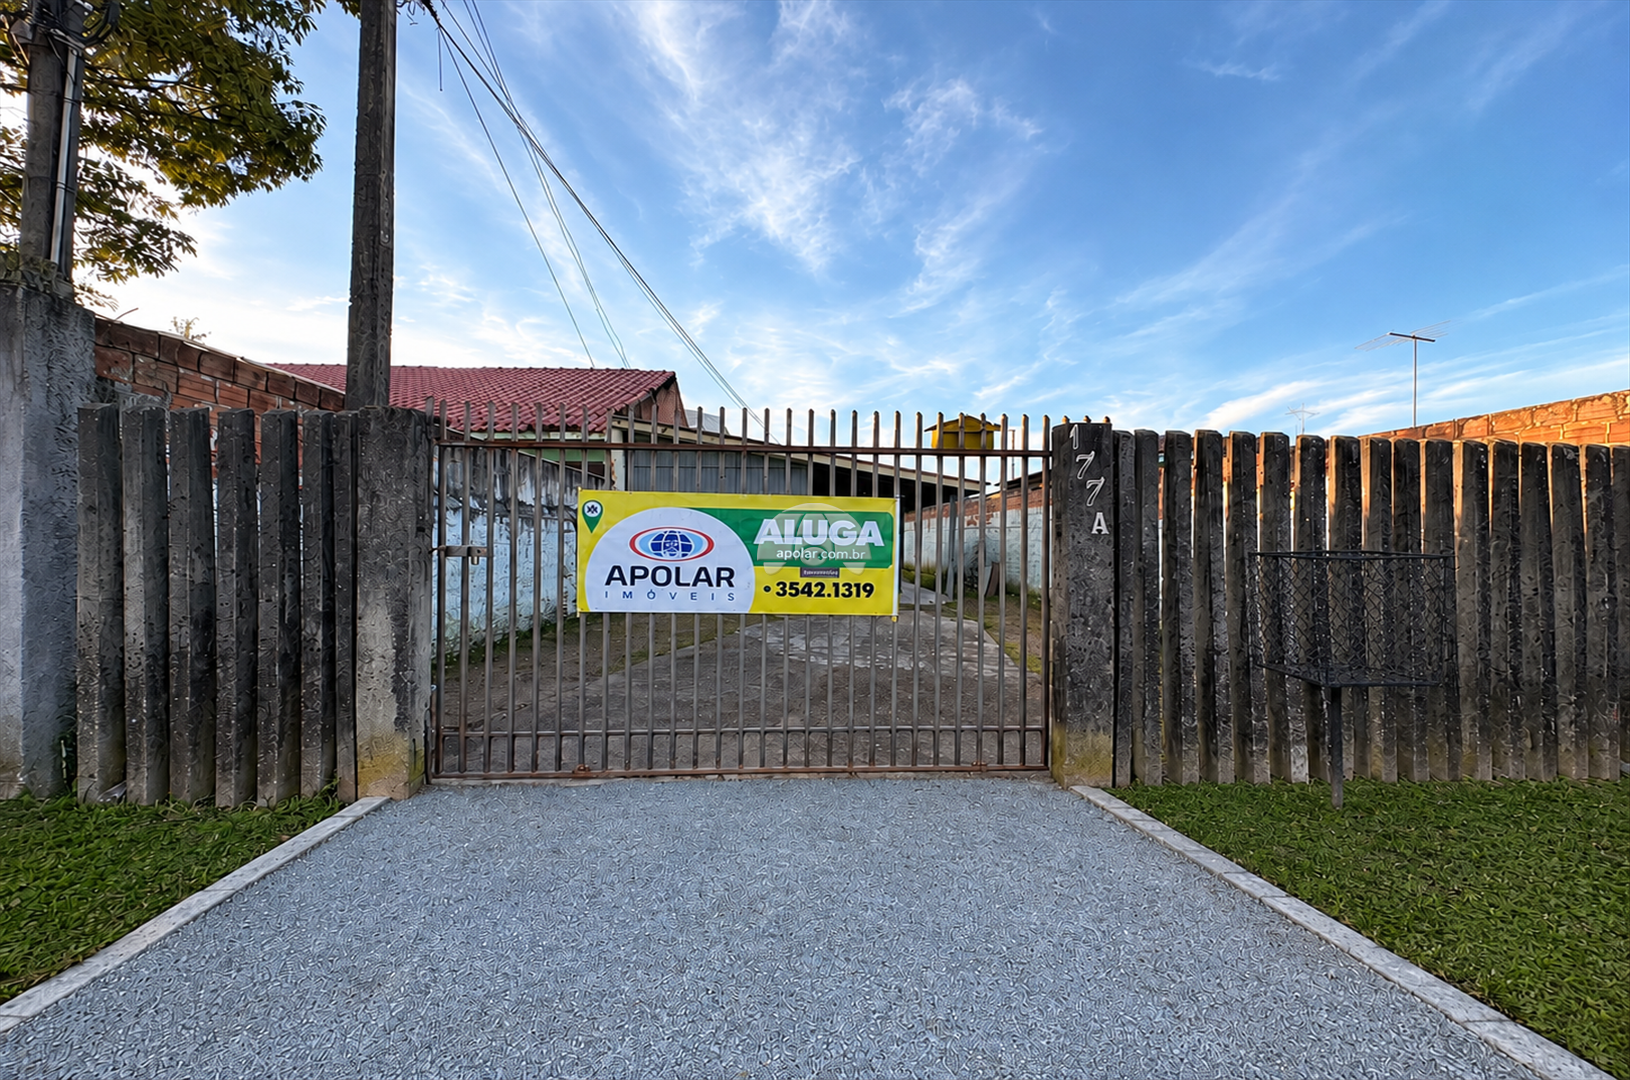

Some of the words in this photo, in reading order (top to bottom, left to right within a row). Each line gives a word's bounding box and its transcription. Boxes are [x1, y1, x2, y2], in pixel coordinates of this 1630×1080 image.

[753, 518, 885, 547] ALUGA
[776, 548, 866, 561] apolar.com.br
[604, 565, 735, 588] APOLAR
[604, 589, 735, 602] IMÓVEIS
[775, 581, 875, 598] 3542.1319
